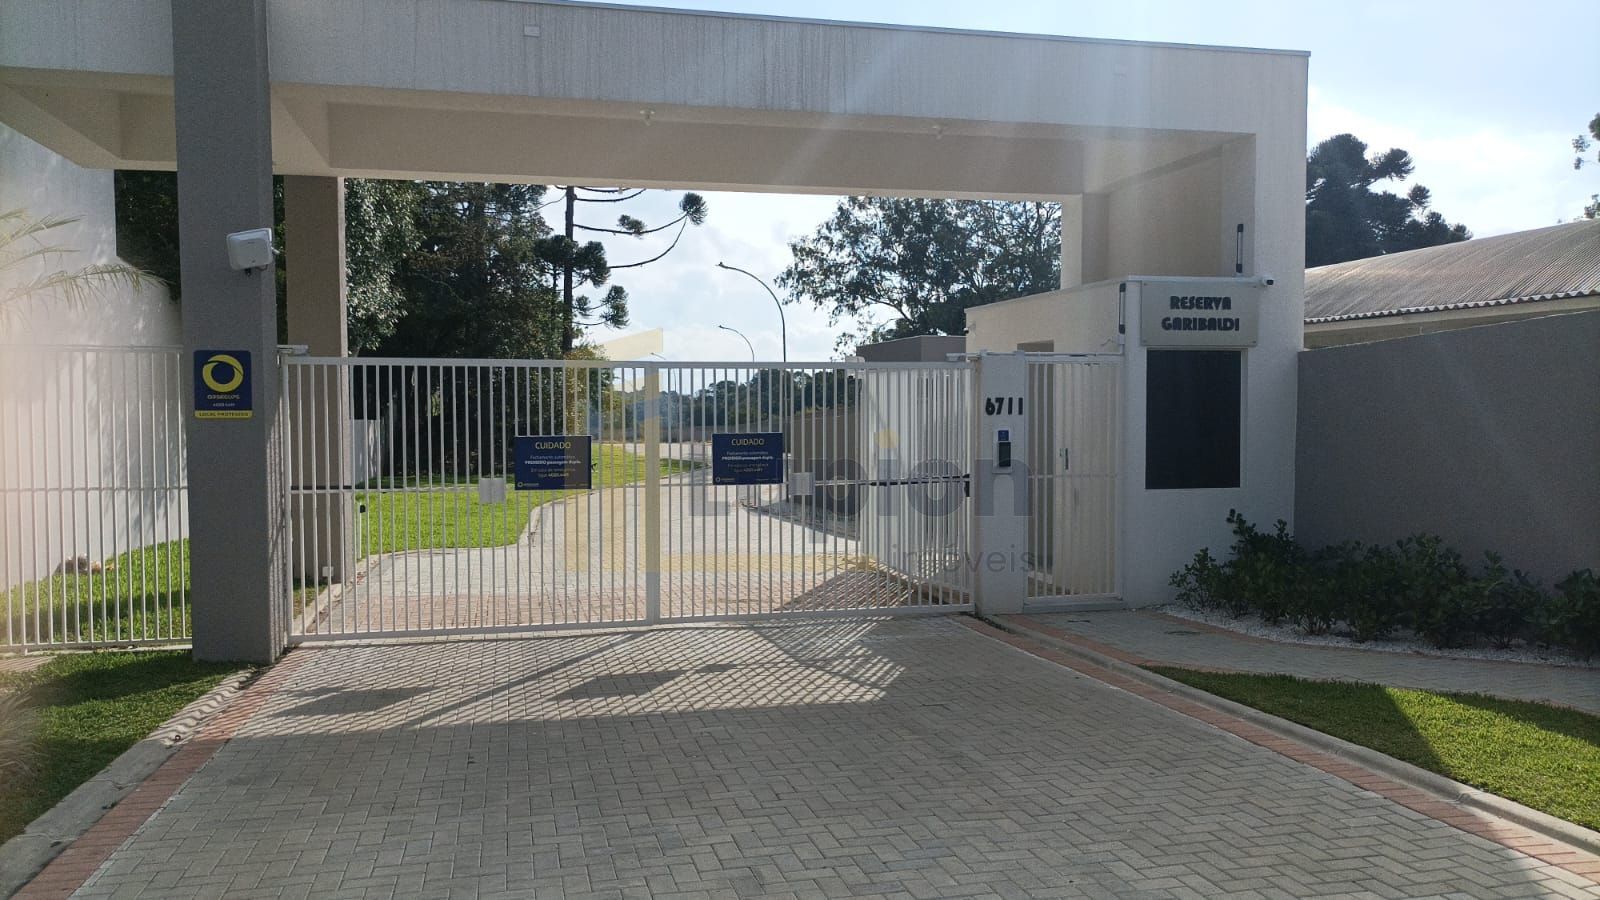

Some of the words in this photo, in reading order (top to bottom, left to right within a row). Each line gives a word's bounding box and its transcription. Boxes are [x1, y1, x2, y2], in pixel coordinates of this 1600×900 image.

[1170, 296, 1231, 310] RESERVA
[1161, 317, 1239, 331] GARIBALDI
[985, 397, 1023, 415] 6711
[535, 441, 572, 450] CUIDADO
[732, 438, 764, 446] CUIDADO
